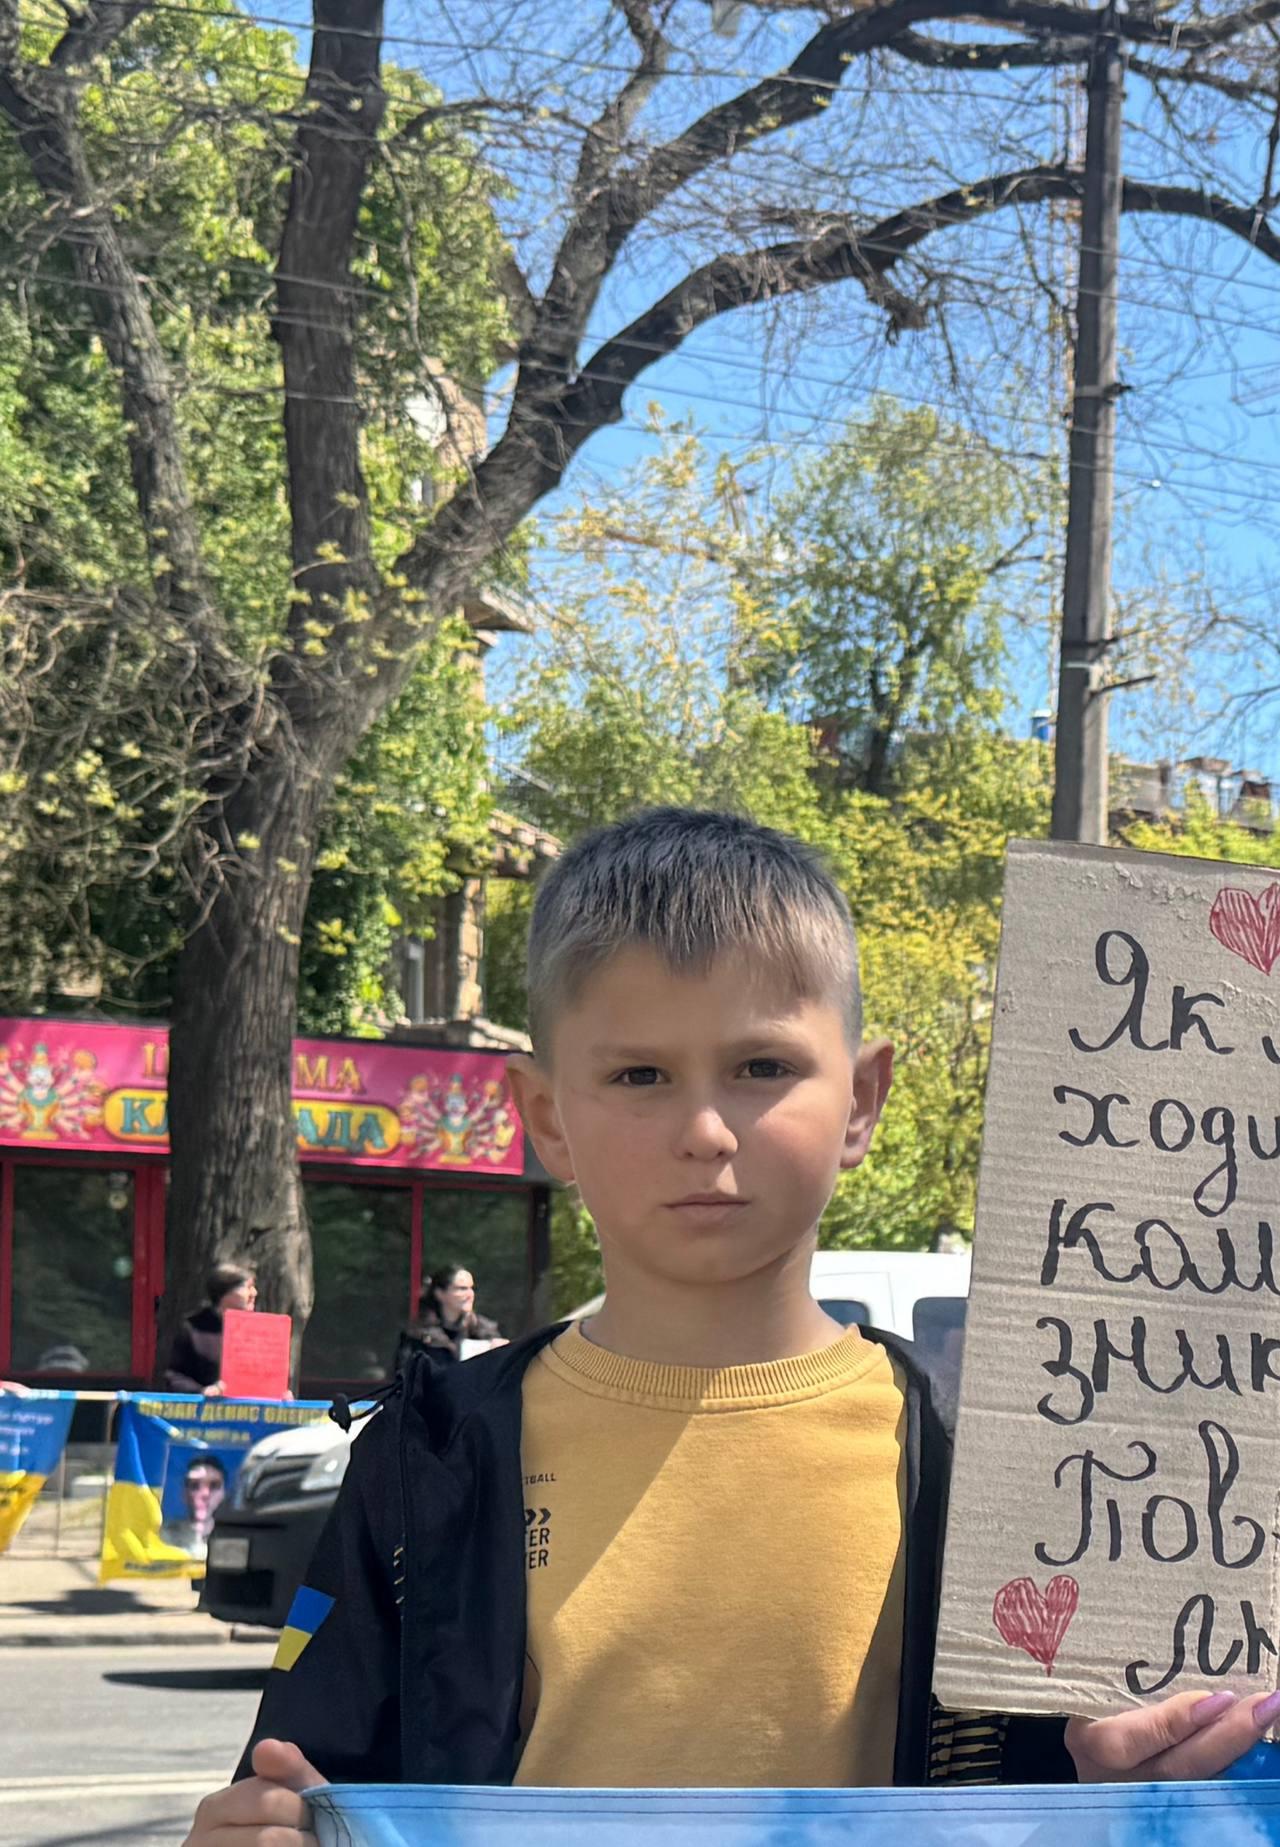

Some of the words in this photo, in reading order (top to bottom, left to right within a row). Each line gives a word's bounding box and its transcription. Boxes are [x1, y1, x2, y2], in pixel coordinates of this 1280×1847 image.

[1069, 931, 1236, 1055] Як
[526, 1527, 550, 1548] ER
[526, 1549, 549, 1570] ER
